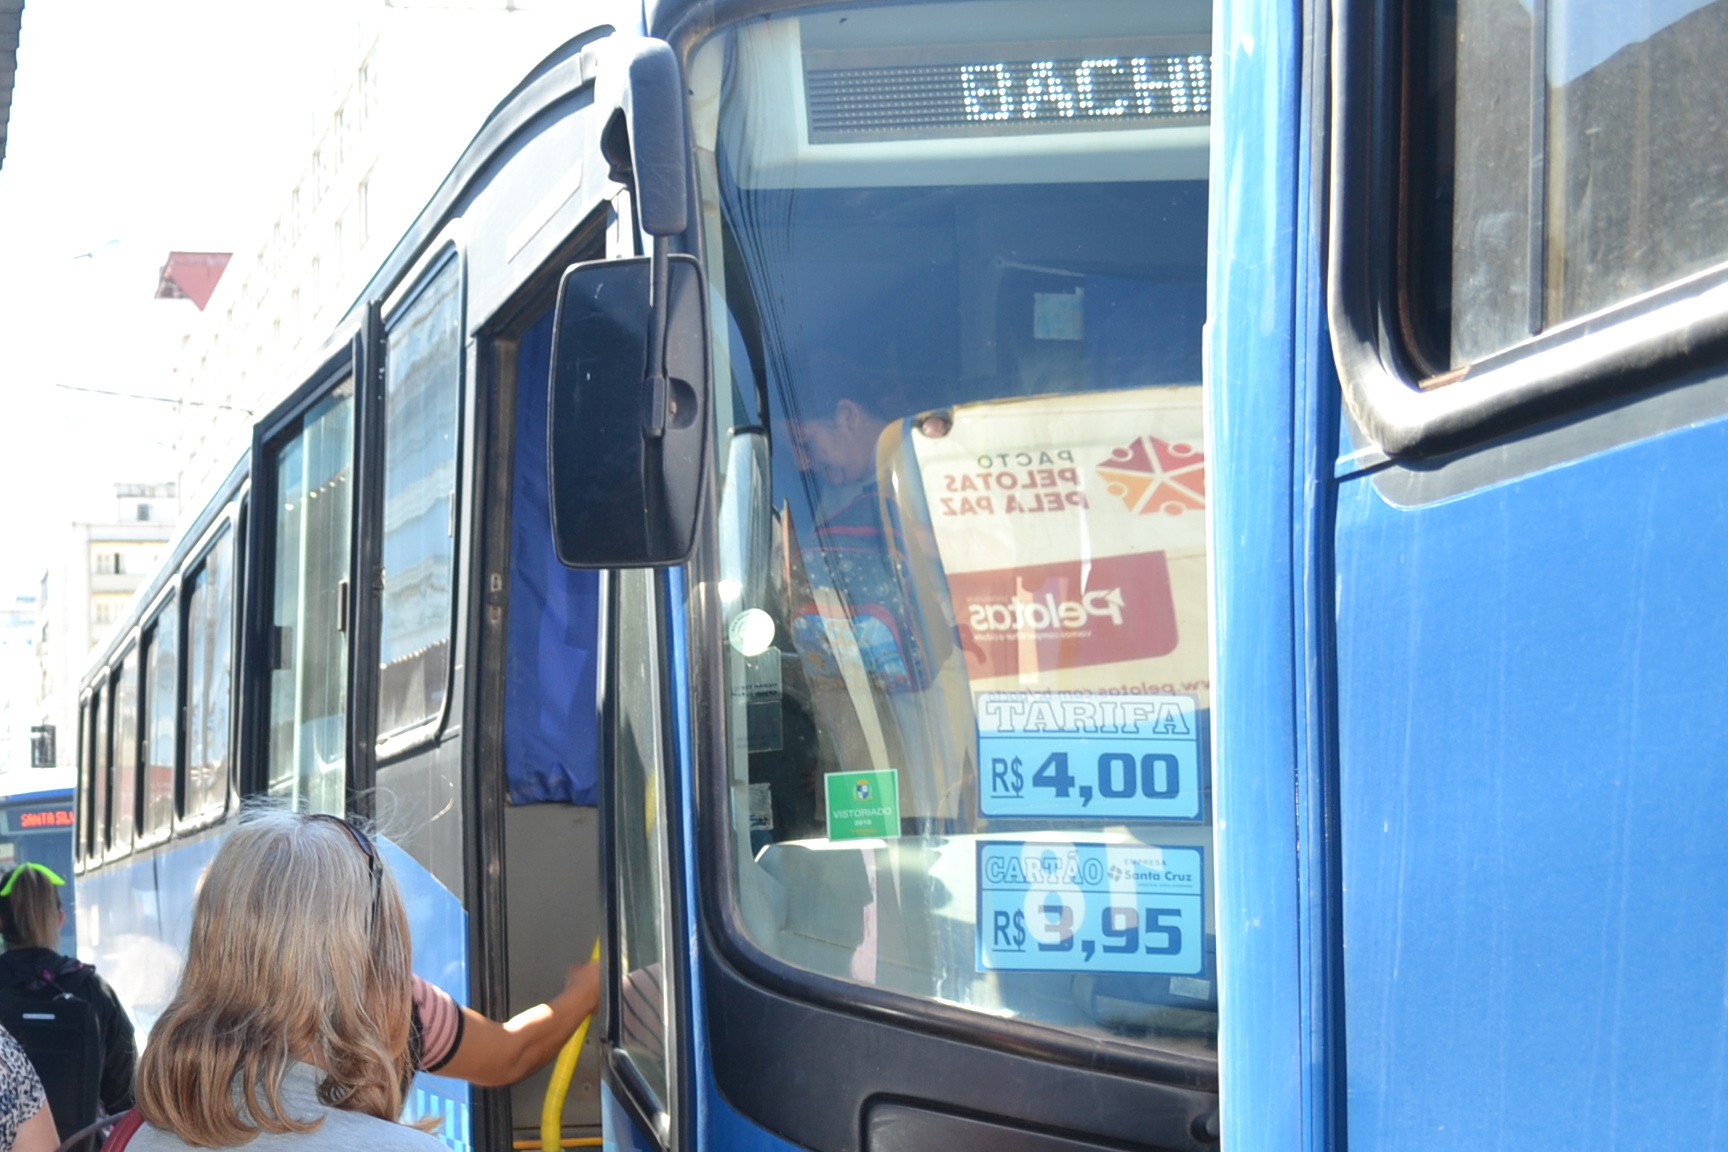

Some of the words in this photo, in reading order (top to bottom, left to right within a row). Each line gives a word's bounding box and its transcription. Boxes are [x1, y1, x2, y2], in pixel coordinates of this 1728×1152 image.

[960, 55, 1214, 120] BACHI
[986, 700, 1191, 735] TARIFA
[991, 755, 1024, 798] R$
[1032, 752, 1180, 807] 4,00
[832, 807, 892, 819] VISTORIADO
[985, 850, 1104, 886] CARTÃO
[1124, 868, 1161, 882] Santa
[1165, 871, 1193, 882] Cruz
[992, 908, 1026, 952] R$
[1038, 904, 1182, 962] 3,95
